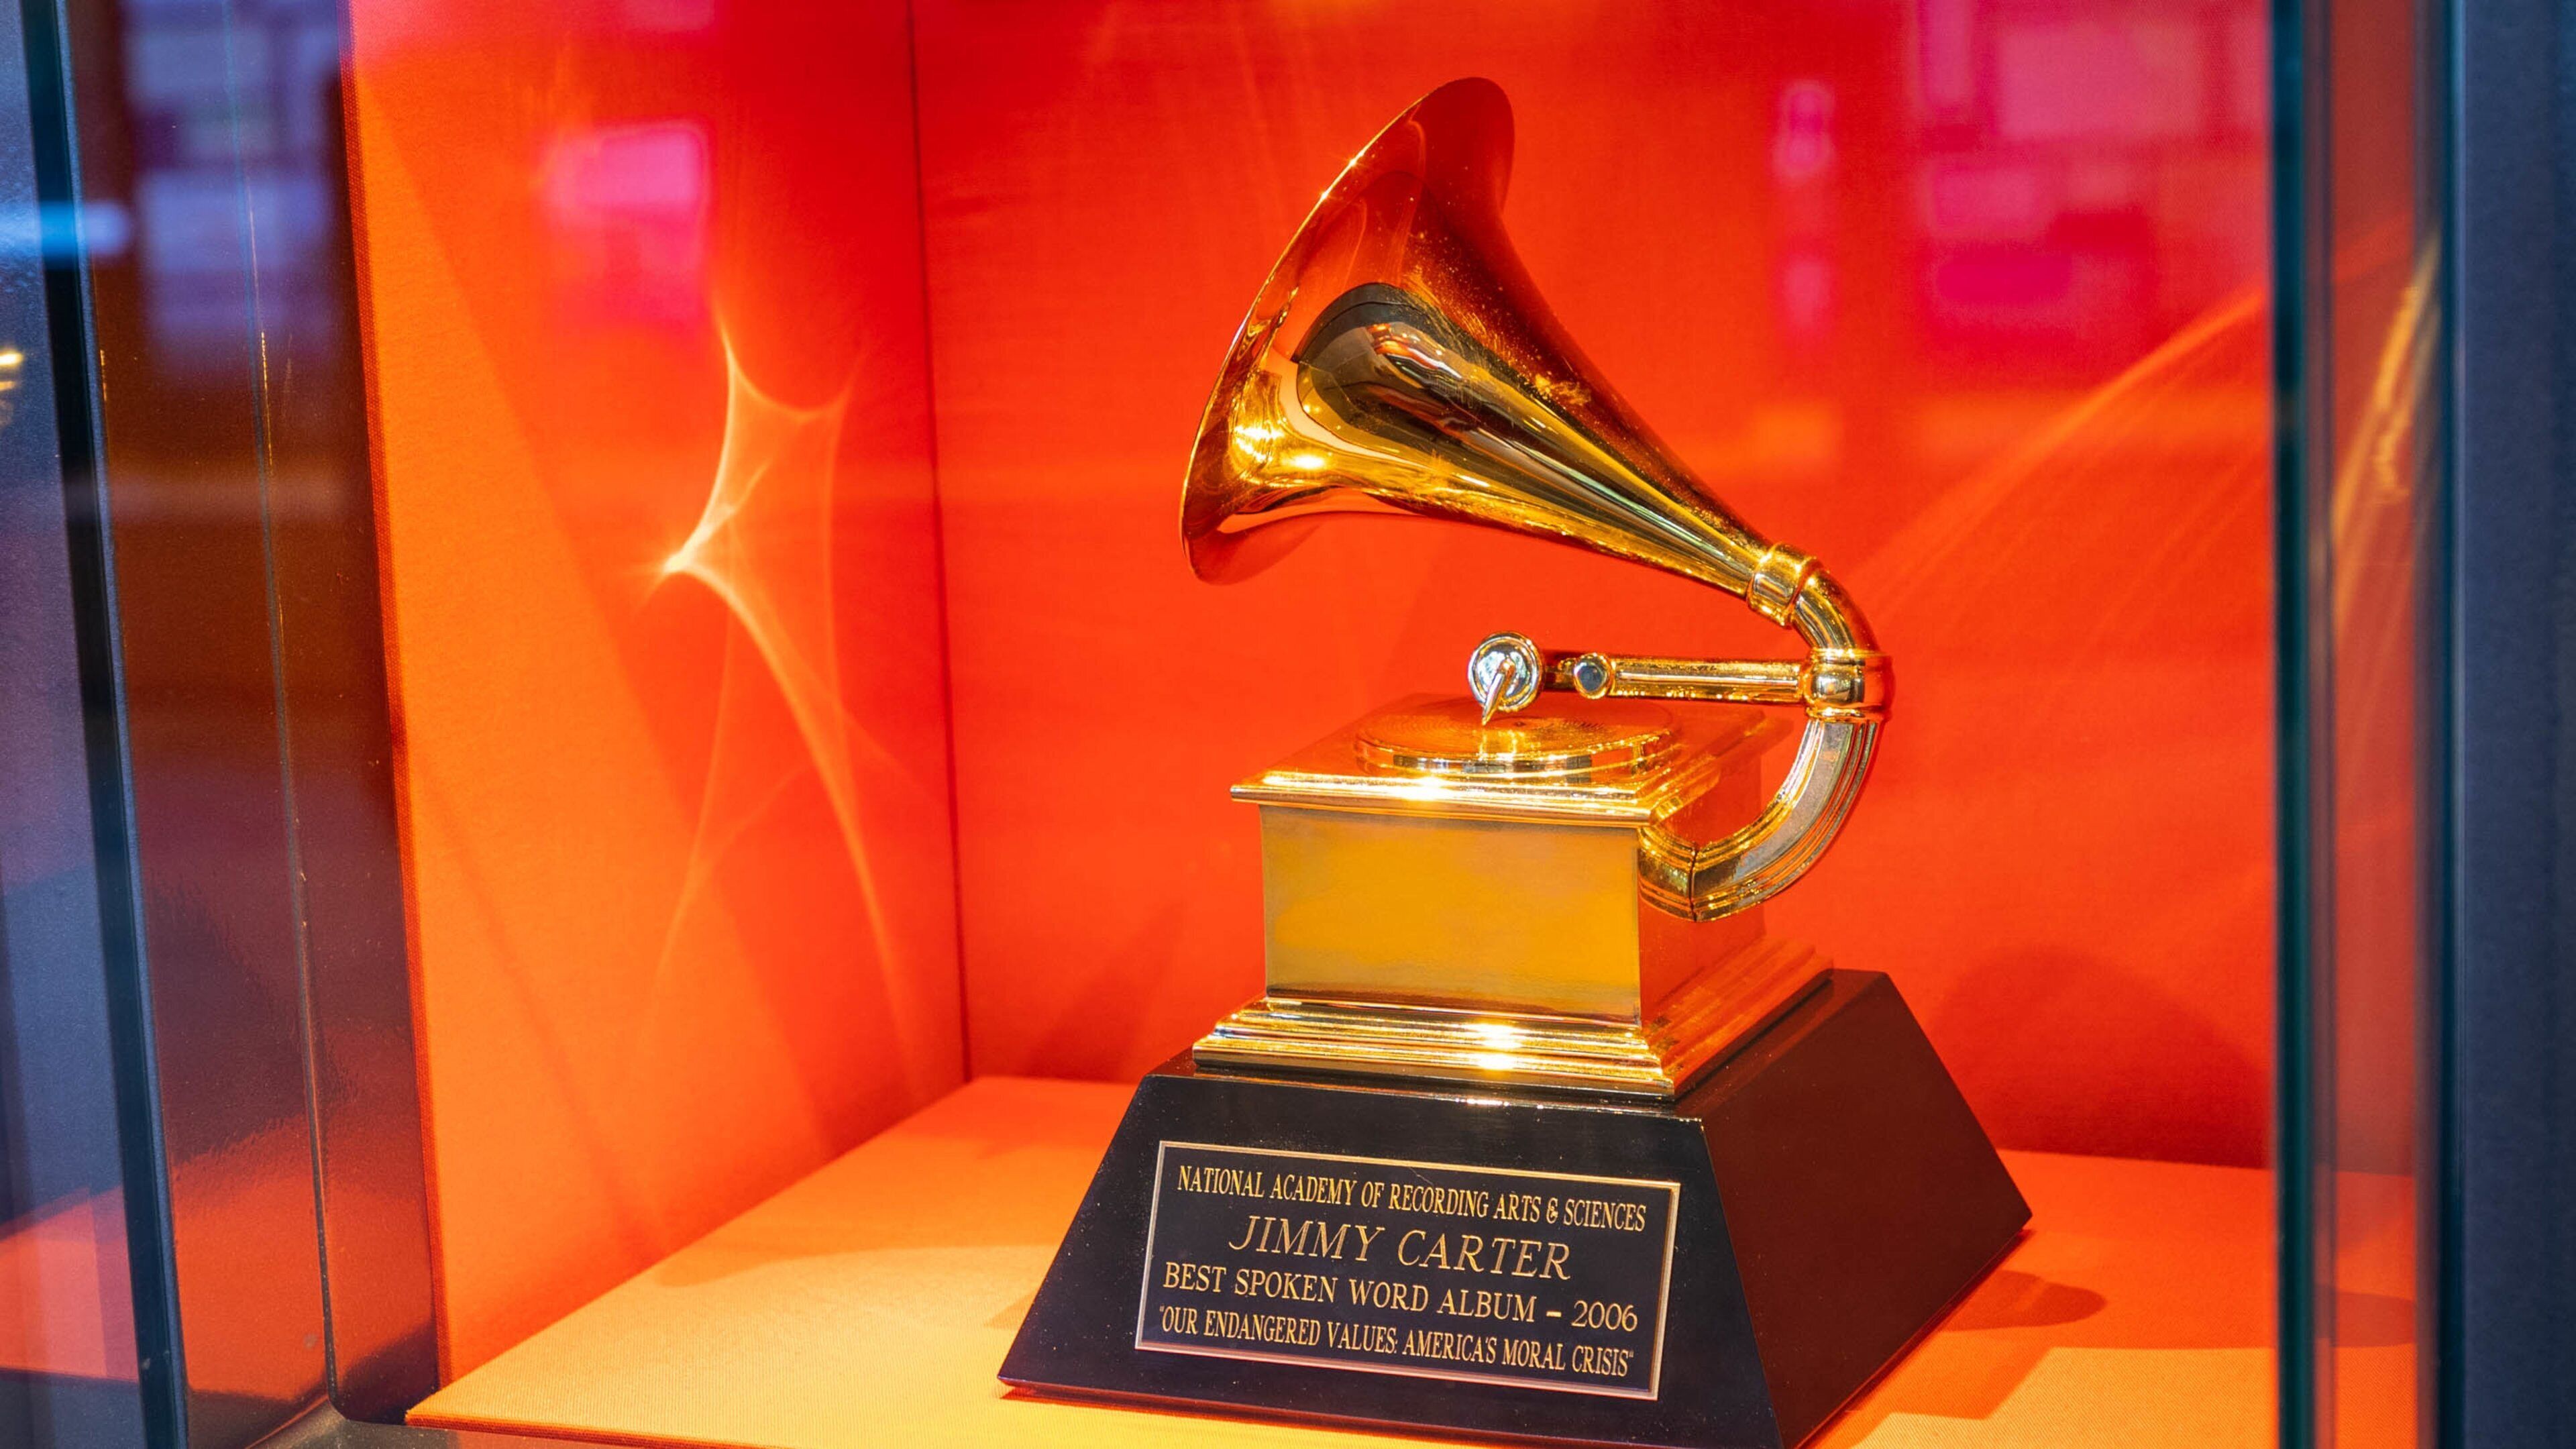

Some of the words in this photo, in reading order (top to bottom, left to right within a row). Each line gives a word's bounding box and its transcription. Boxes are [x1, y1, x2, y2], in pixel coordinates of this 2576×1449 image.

[1177, 1165, 1265, 1197] NATIONAL
[1269, 1174, 1358, 1205] ACADEMY
[1361, 1181, 1385, 1208] OF
[1388, 1183, 1489, 1218] RECORDING
[1493, 1193, 1542, 1222] ARTS
[1546, 1197, 1558, 1224] &
[1563, 1198, 1646, 1232] SCIENCES
[1228, 1216, 1385, 1261] JIMMY
[1398, 1230, 1570, 1280] CARTER
[1163, 1262, 1226, 1293] BEST
[1234, 1269, 1338, 1303] SPOKEN
[1349, 1279, 1428, 1311] WORD
[1436, 1289, 1537, 1322] ALBUM
[1571, 1300, 1638, 1332] 2006
[1203, 1309, 1320, 1346] ENDANGERED
[1327, 1321, 1398, 1354] VALUES:
[1402, 1330, 1497, 1364] AMERICA'S
[1501, 1338, 1566, 1371] MORAL
